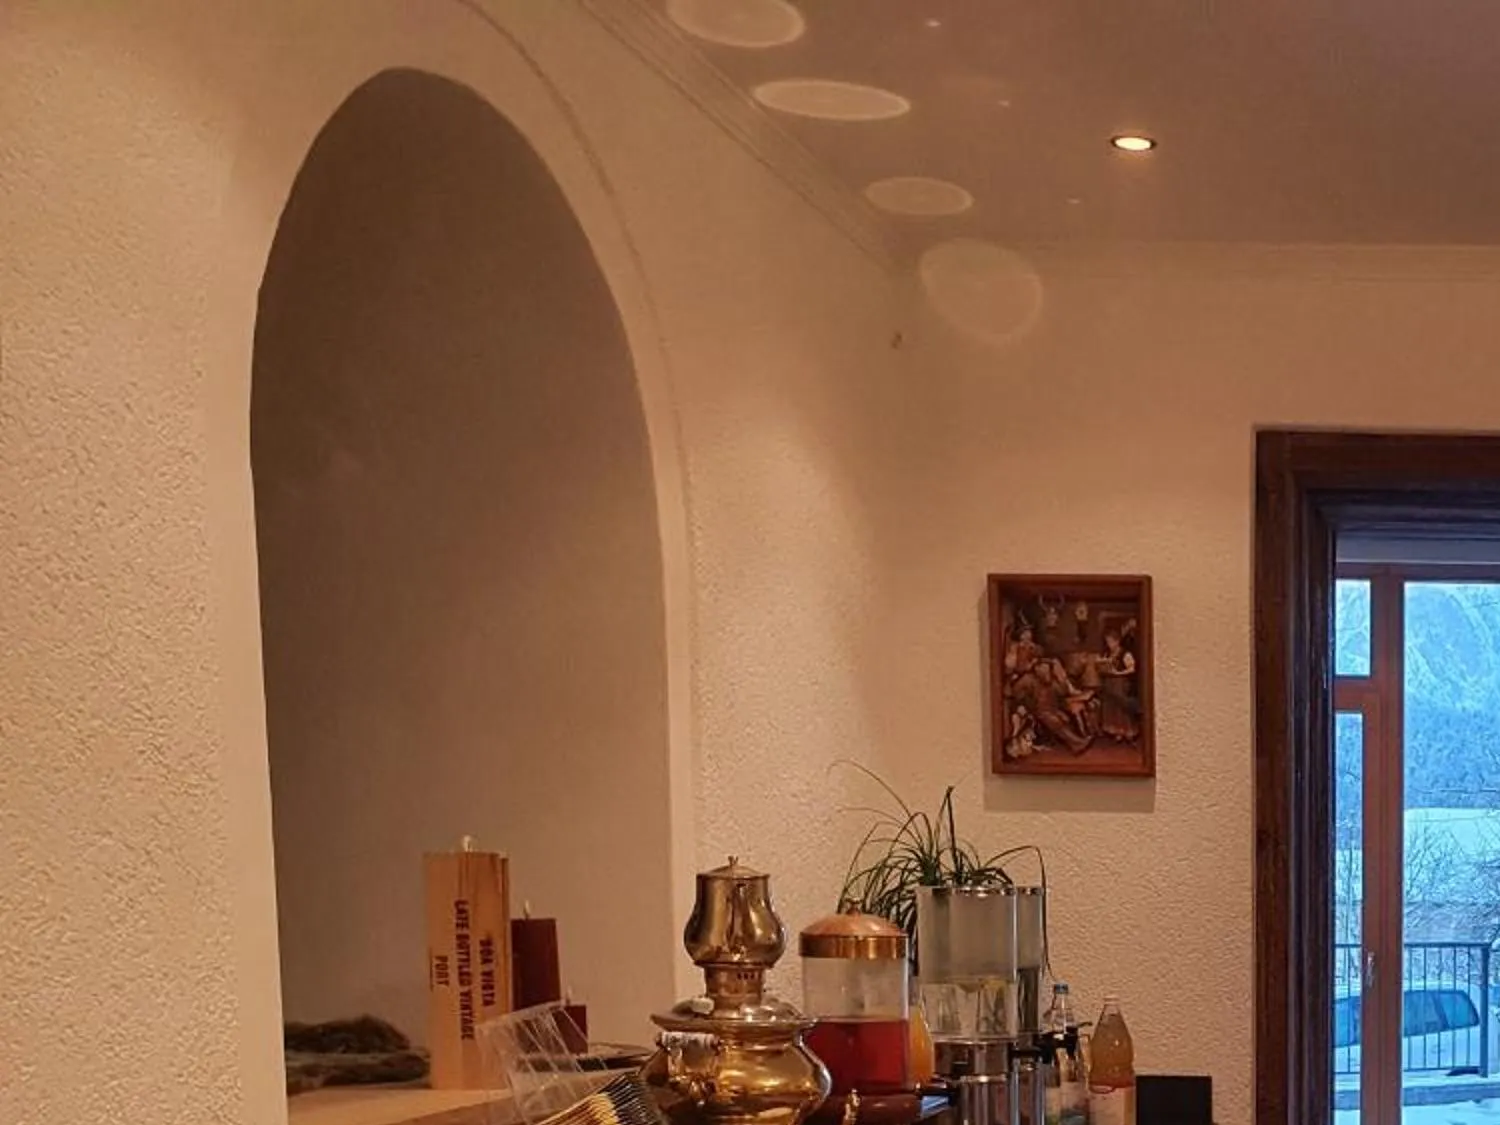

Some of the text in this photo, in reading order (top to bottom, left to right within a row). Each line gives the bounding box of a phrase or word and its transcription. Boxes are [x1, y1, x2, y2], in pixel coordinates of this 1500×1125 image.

[435, 955, 449, 987] PORT
[454, 900, 475, 1040] LATE BOTTLED VINTAGE
[480, 970, 495, 1007] VISTA
